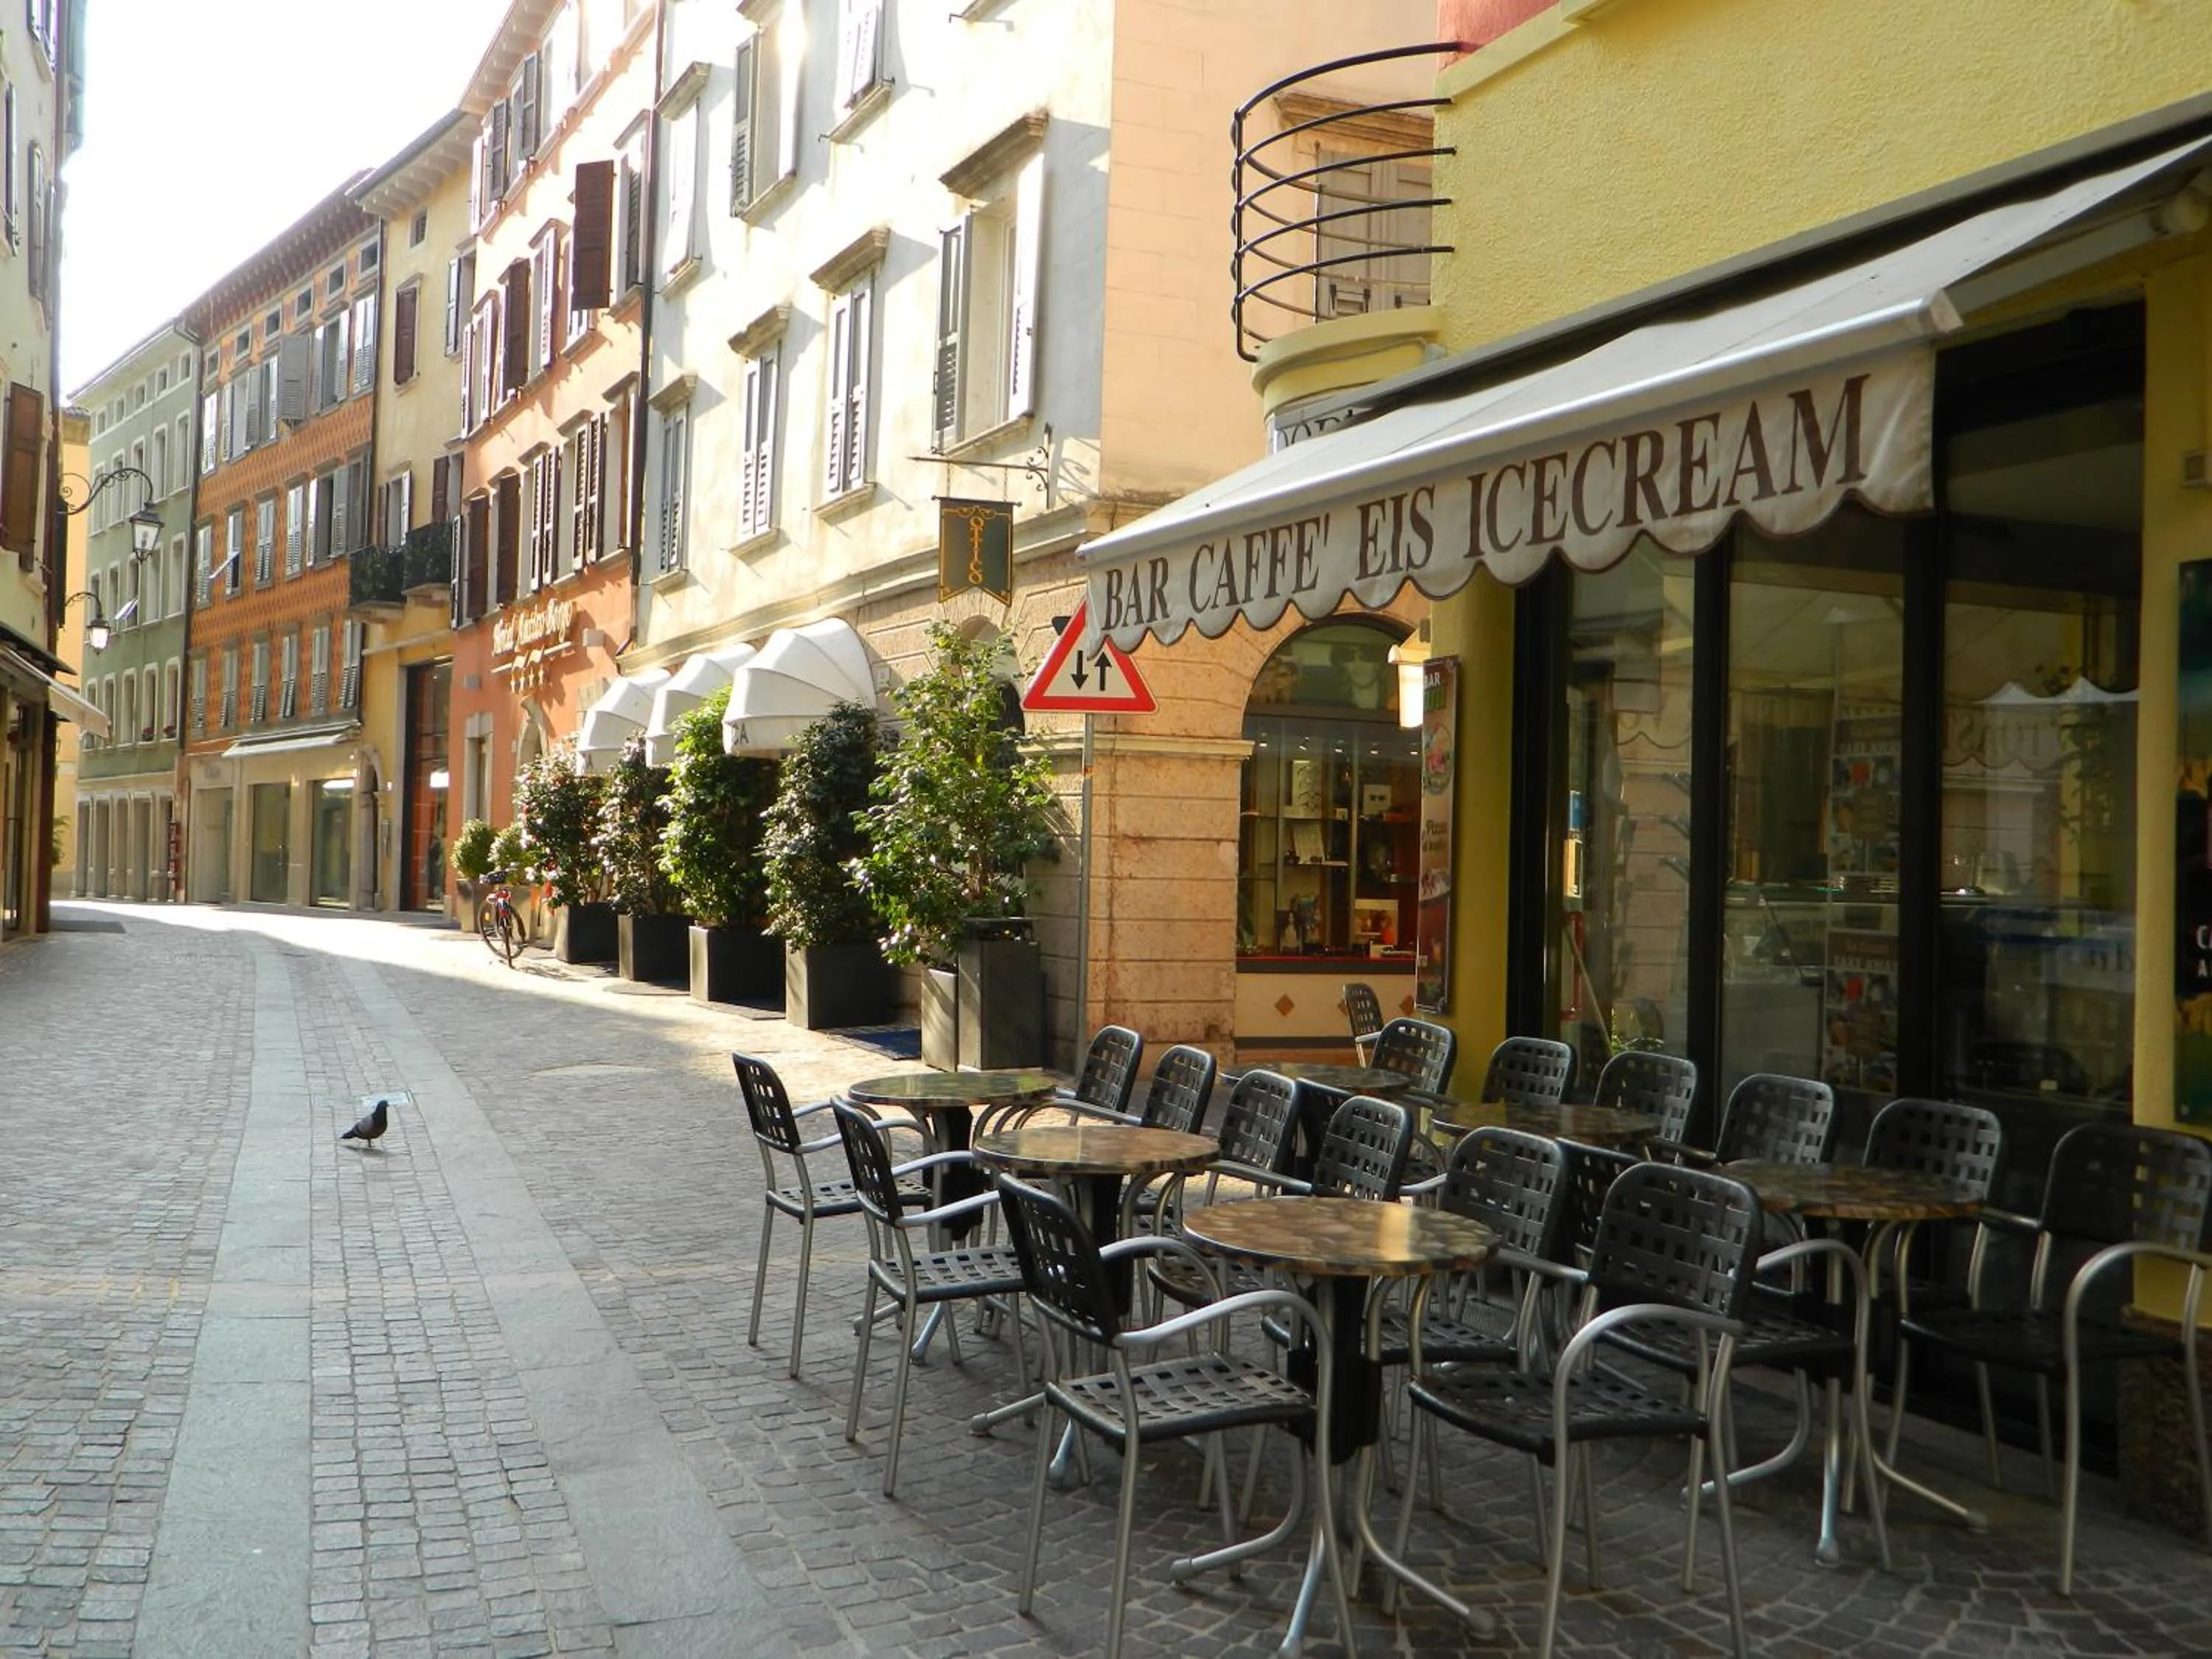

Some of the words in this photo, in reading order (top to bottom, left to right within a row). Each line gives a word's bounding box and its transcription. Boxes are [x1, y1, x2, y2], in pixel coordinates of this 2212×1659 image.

[1102, 557, 1171, 630] BAR
[1189, 512, 1330, 614] CAFFE'
[1355, 484, 1436, 582] EIS
[1463, 374, 1872, 559] ICECREAM
